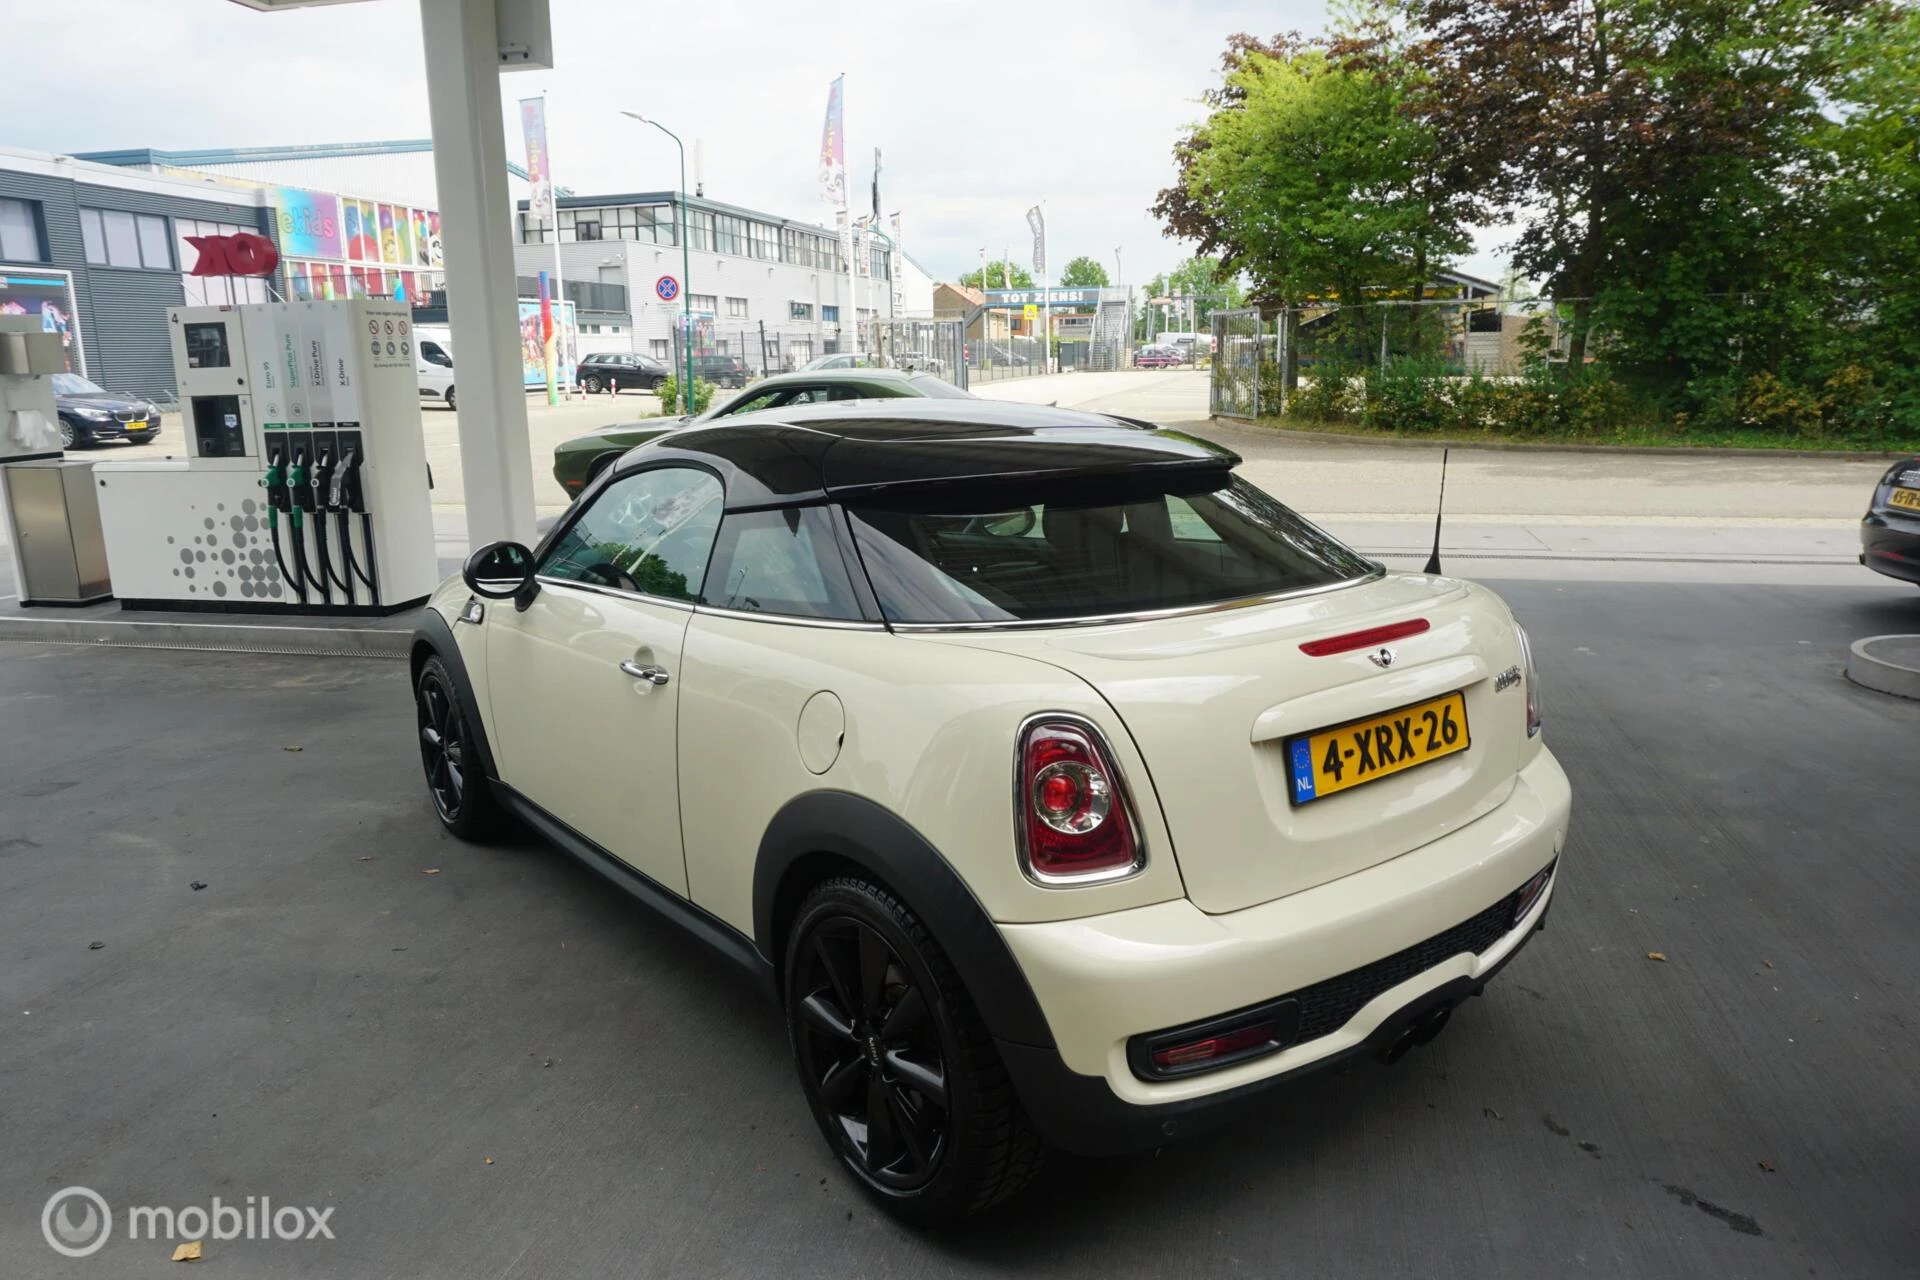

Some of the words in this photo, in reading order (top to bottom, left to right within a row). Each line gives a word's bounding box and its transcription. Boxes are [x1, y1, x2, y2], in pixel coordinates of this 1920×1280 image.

[1002, 293, 1029, 304] TOT
[1034, 291, 1084, 303] ZENS!
[171, 313, 179, 324] 4
[263, 361, 270, 371] 95
[313, 359, 321, 387] X-Drive
[338, 358, 346, 387] X-Drive
[1322, 704, 1459, 783] 4-XRX-26
[1297, 776, 1313, 792] NL
